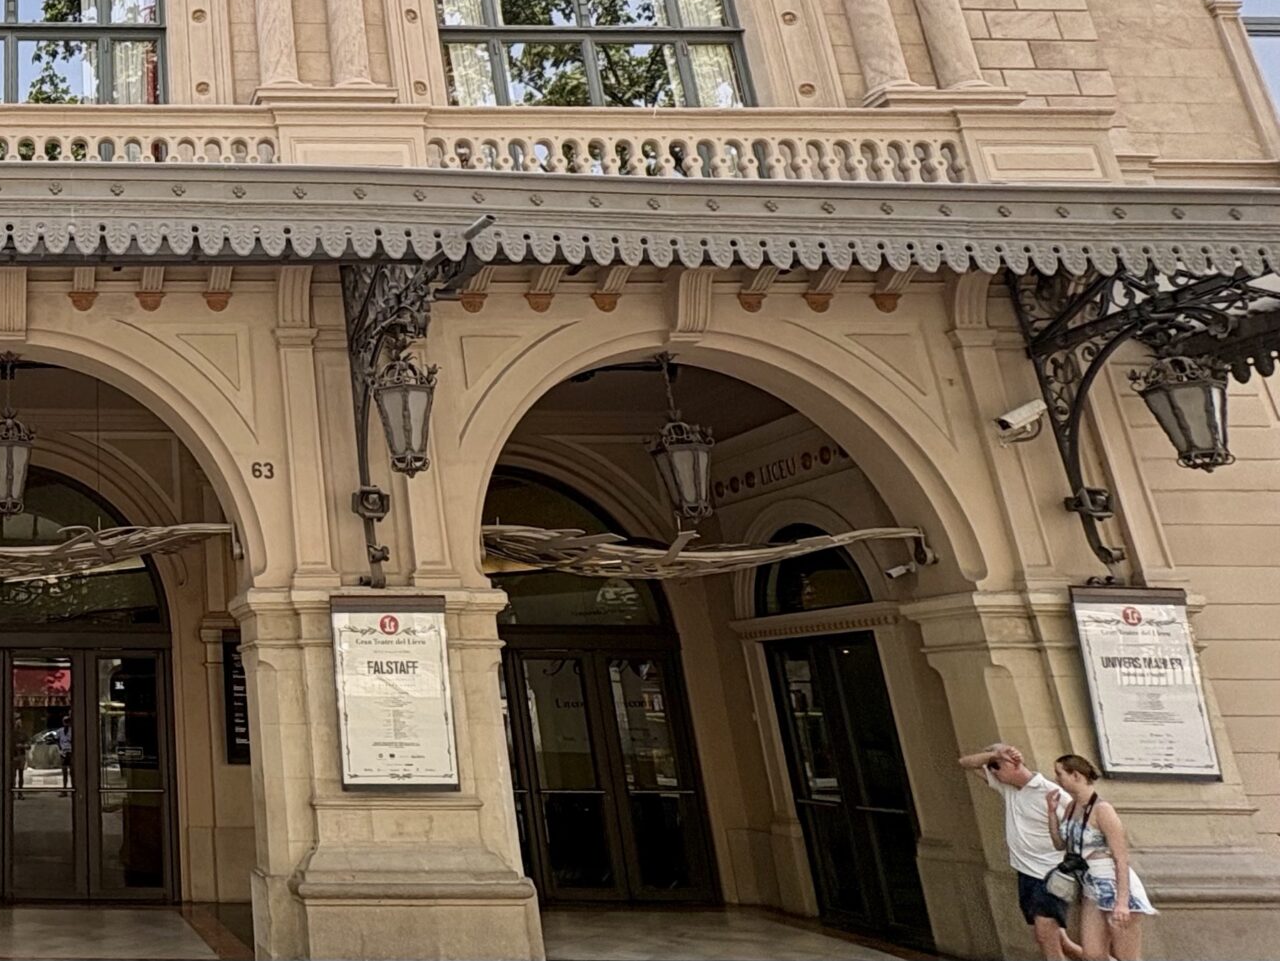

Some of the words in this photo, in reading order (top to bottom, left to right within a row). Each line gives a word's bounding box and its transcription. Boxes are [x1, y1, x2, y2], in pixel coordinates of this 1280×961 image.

[251, 461, 274, 479] 63
[759, 457, 796, 485] LICEU
[367, 660, 419, 675] FALSTAFF
[1101, 656, 1142, 668] UNIVERS
